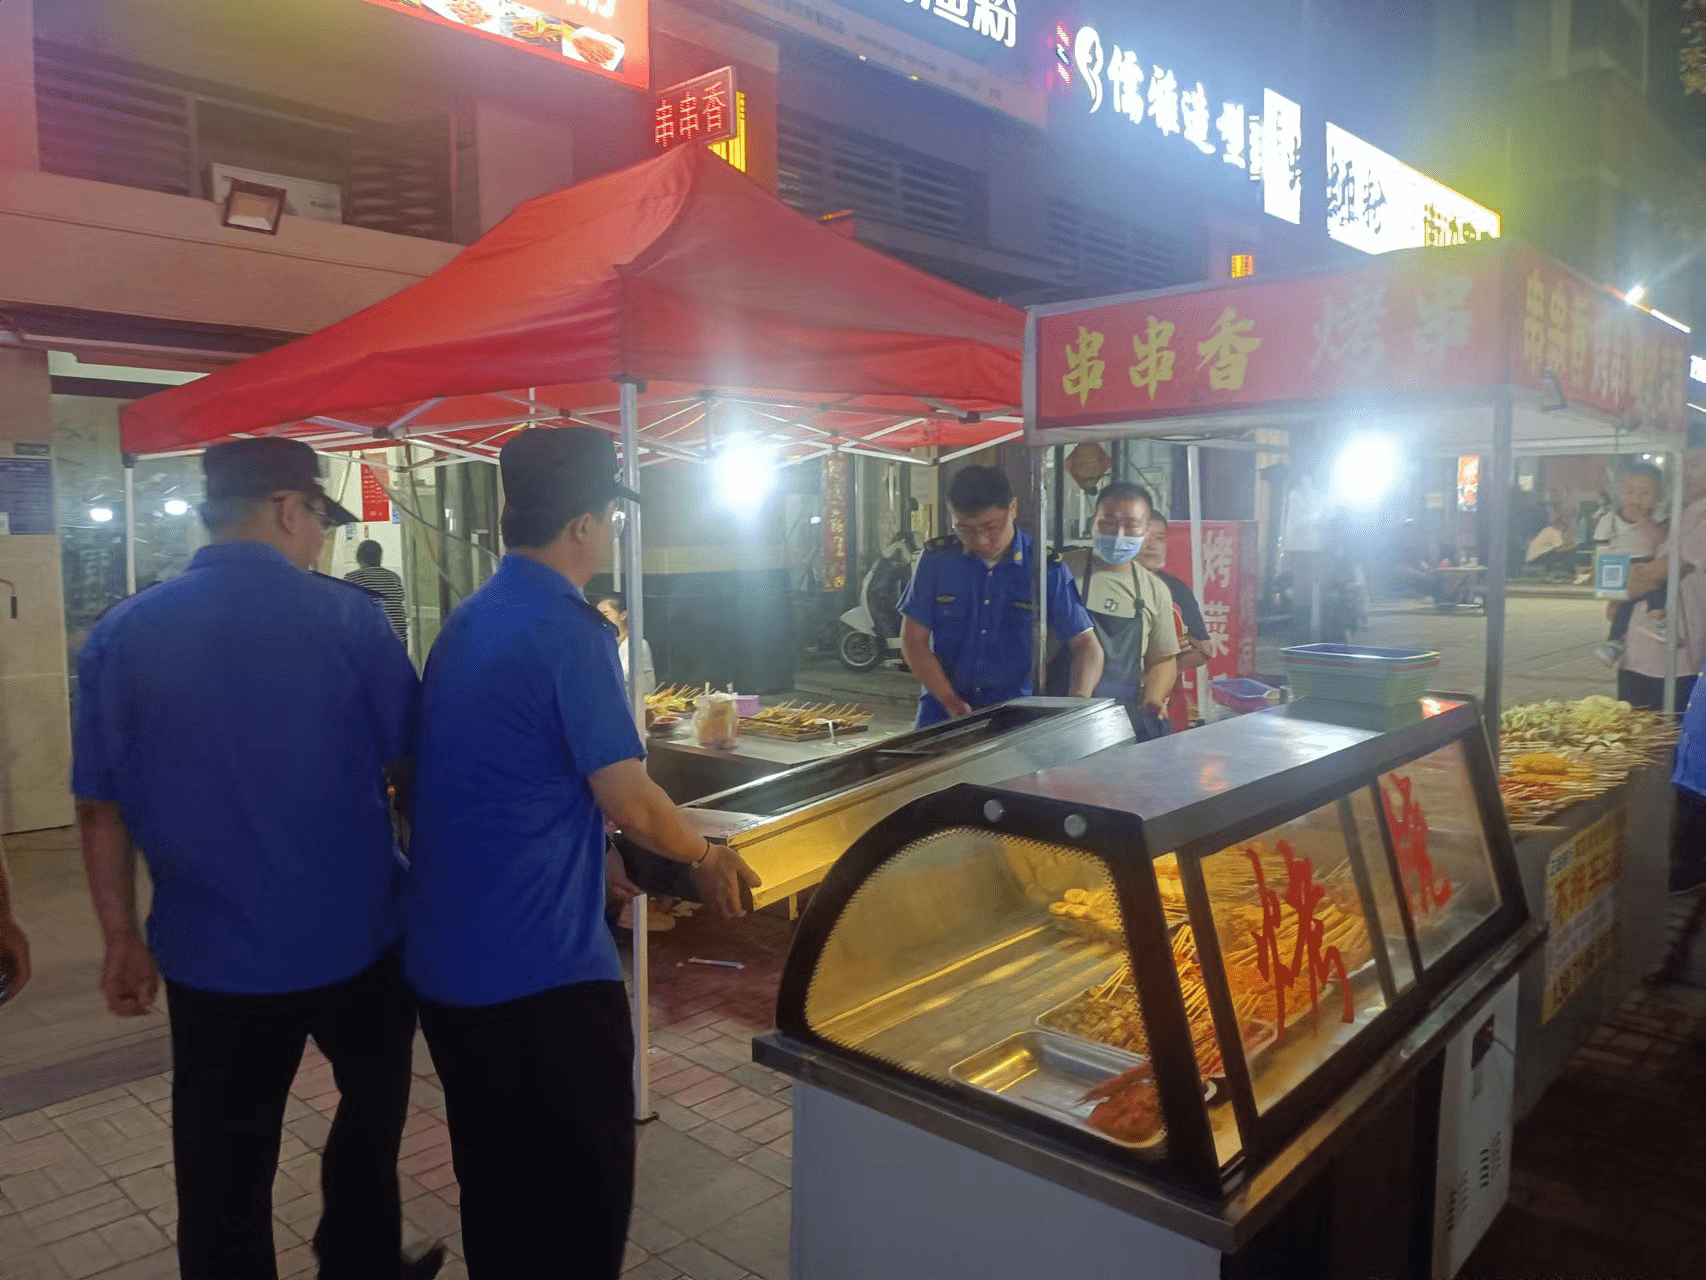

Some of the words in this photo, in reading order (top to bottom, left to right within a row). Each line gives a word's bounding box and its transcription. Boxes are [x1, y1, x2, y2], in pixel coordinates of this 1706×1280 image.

[655, 81, 727, 147] 串串香
[1062, 306, 1264, 408] 串串香
